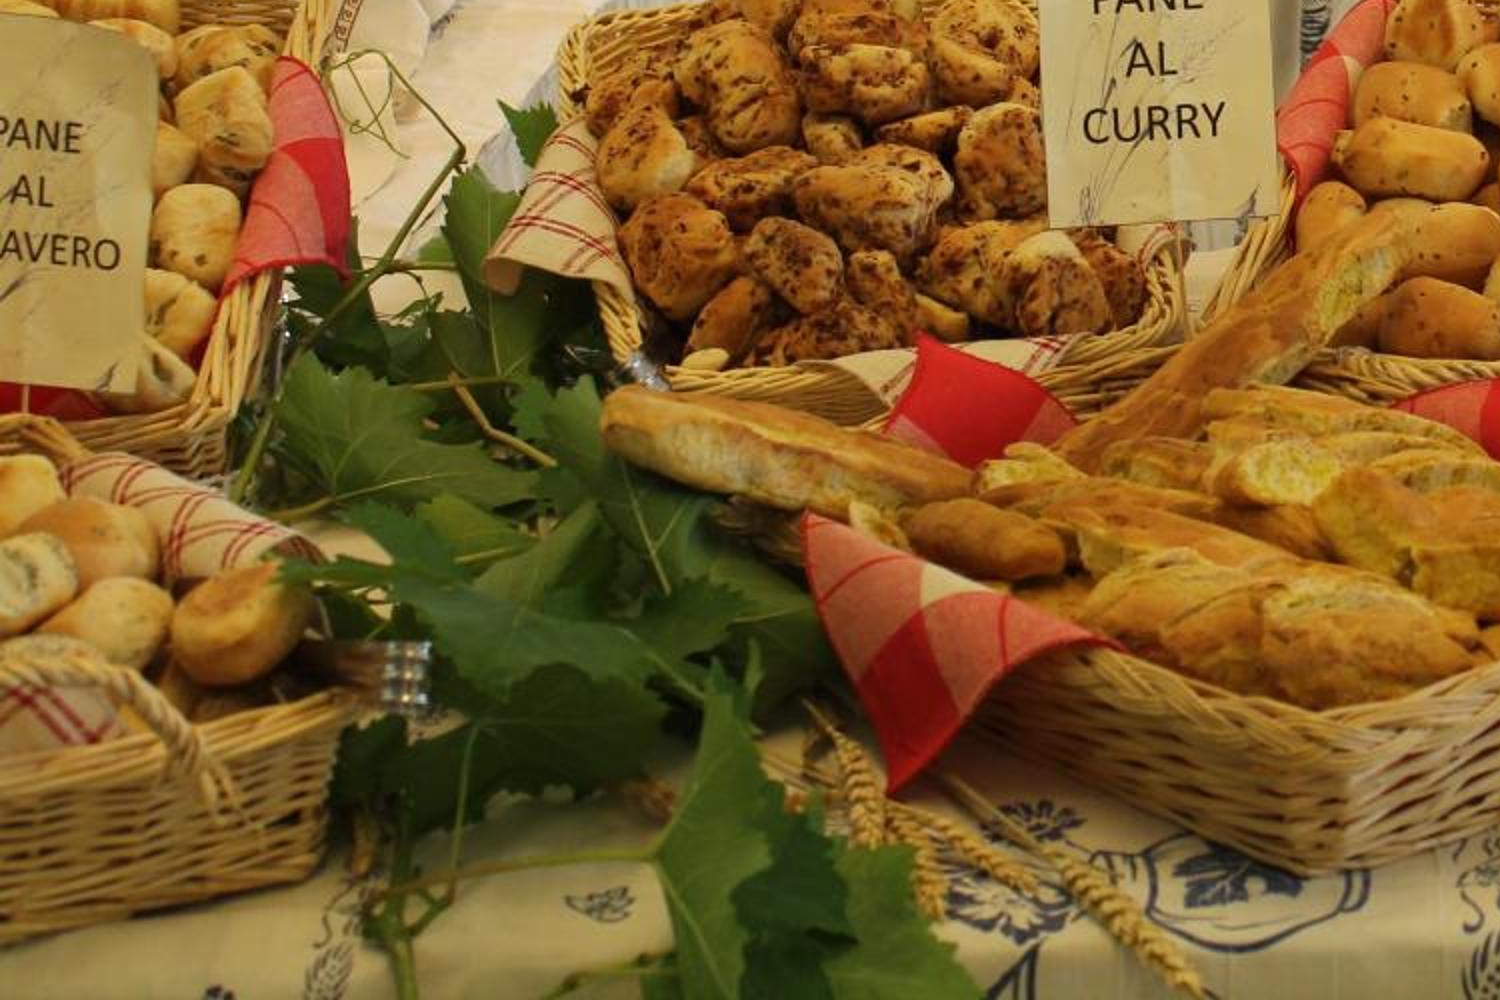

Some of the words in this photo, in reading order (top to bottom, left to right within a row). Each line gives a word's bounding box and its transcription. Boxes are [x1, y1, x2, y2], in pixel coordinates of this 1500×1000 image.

[1125, 41, 1178, 78] AL
[1083, 101, 1226, 144] CURRY
[10, 174, 54, 208] AL
